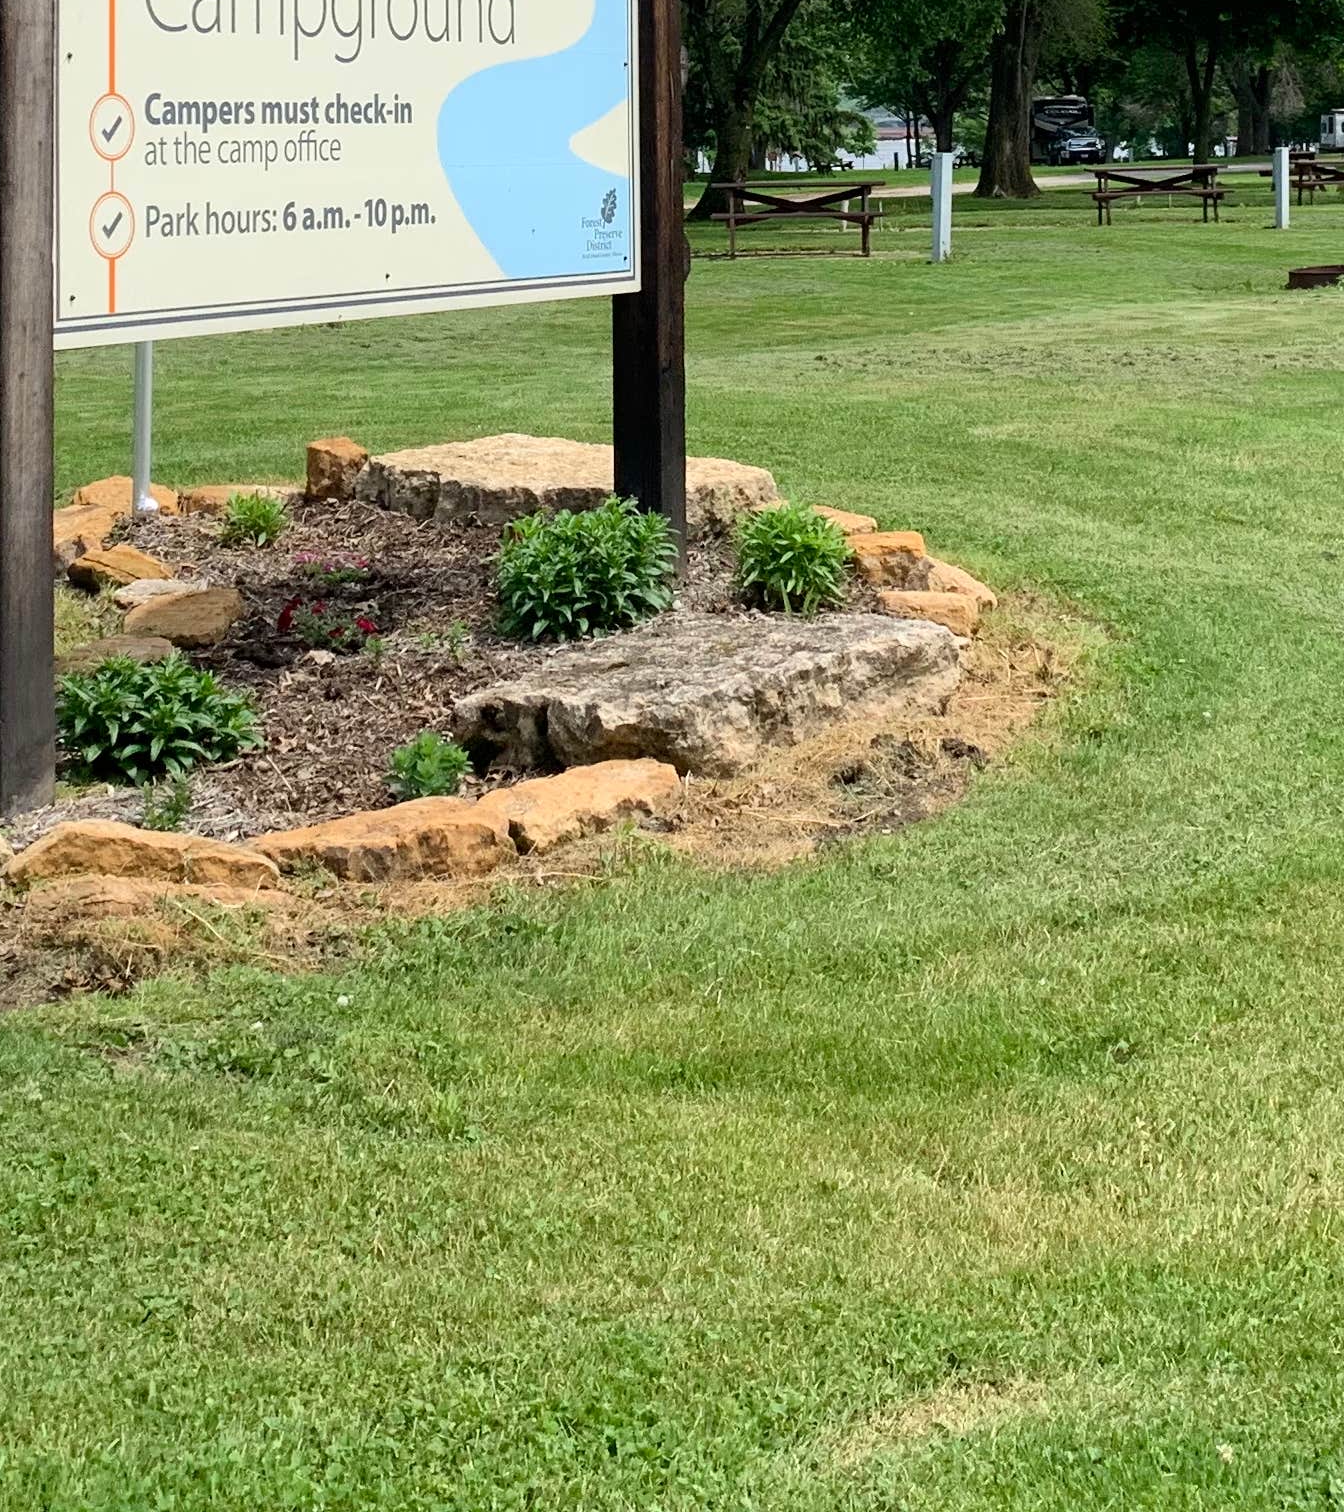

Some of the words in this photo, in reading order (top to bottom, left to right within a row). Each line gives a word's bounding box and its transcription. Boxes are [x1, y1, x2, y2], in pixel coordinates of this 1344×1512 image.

[144, 92, 256, 134] Campers
[261, 96, 320, 125] must
[324, 92, 413, 125] check-in
[144, 136, 168, 166] at
[172, 130, 212, 165] the
[217, 139, 279, 172] camp
[283, 129, 342, 163] office
[145, 202, 200, 238] Park
[205, 201, 278, 236] hours:
[282, 200, 297, 232] 6
[301, 206, 352, 231] a.m.
[364, 197, 388, 228] 10
[391, 202, 437, 235] p.m.
[581, 216, 602, 229] Forest
[586, 239, 613, 251] District
[594, 228, 623, 240] Preserve
